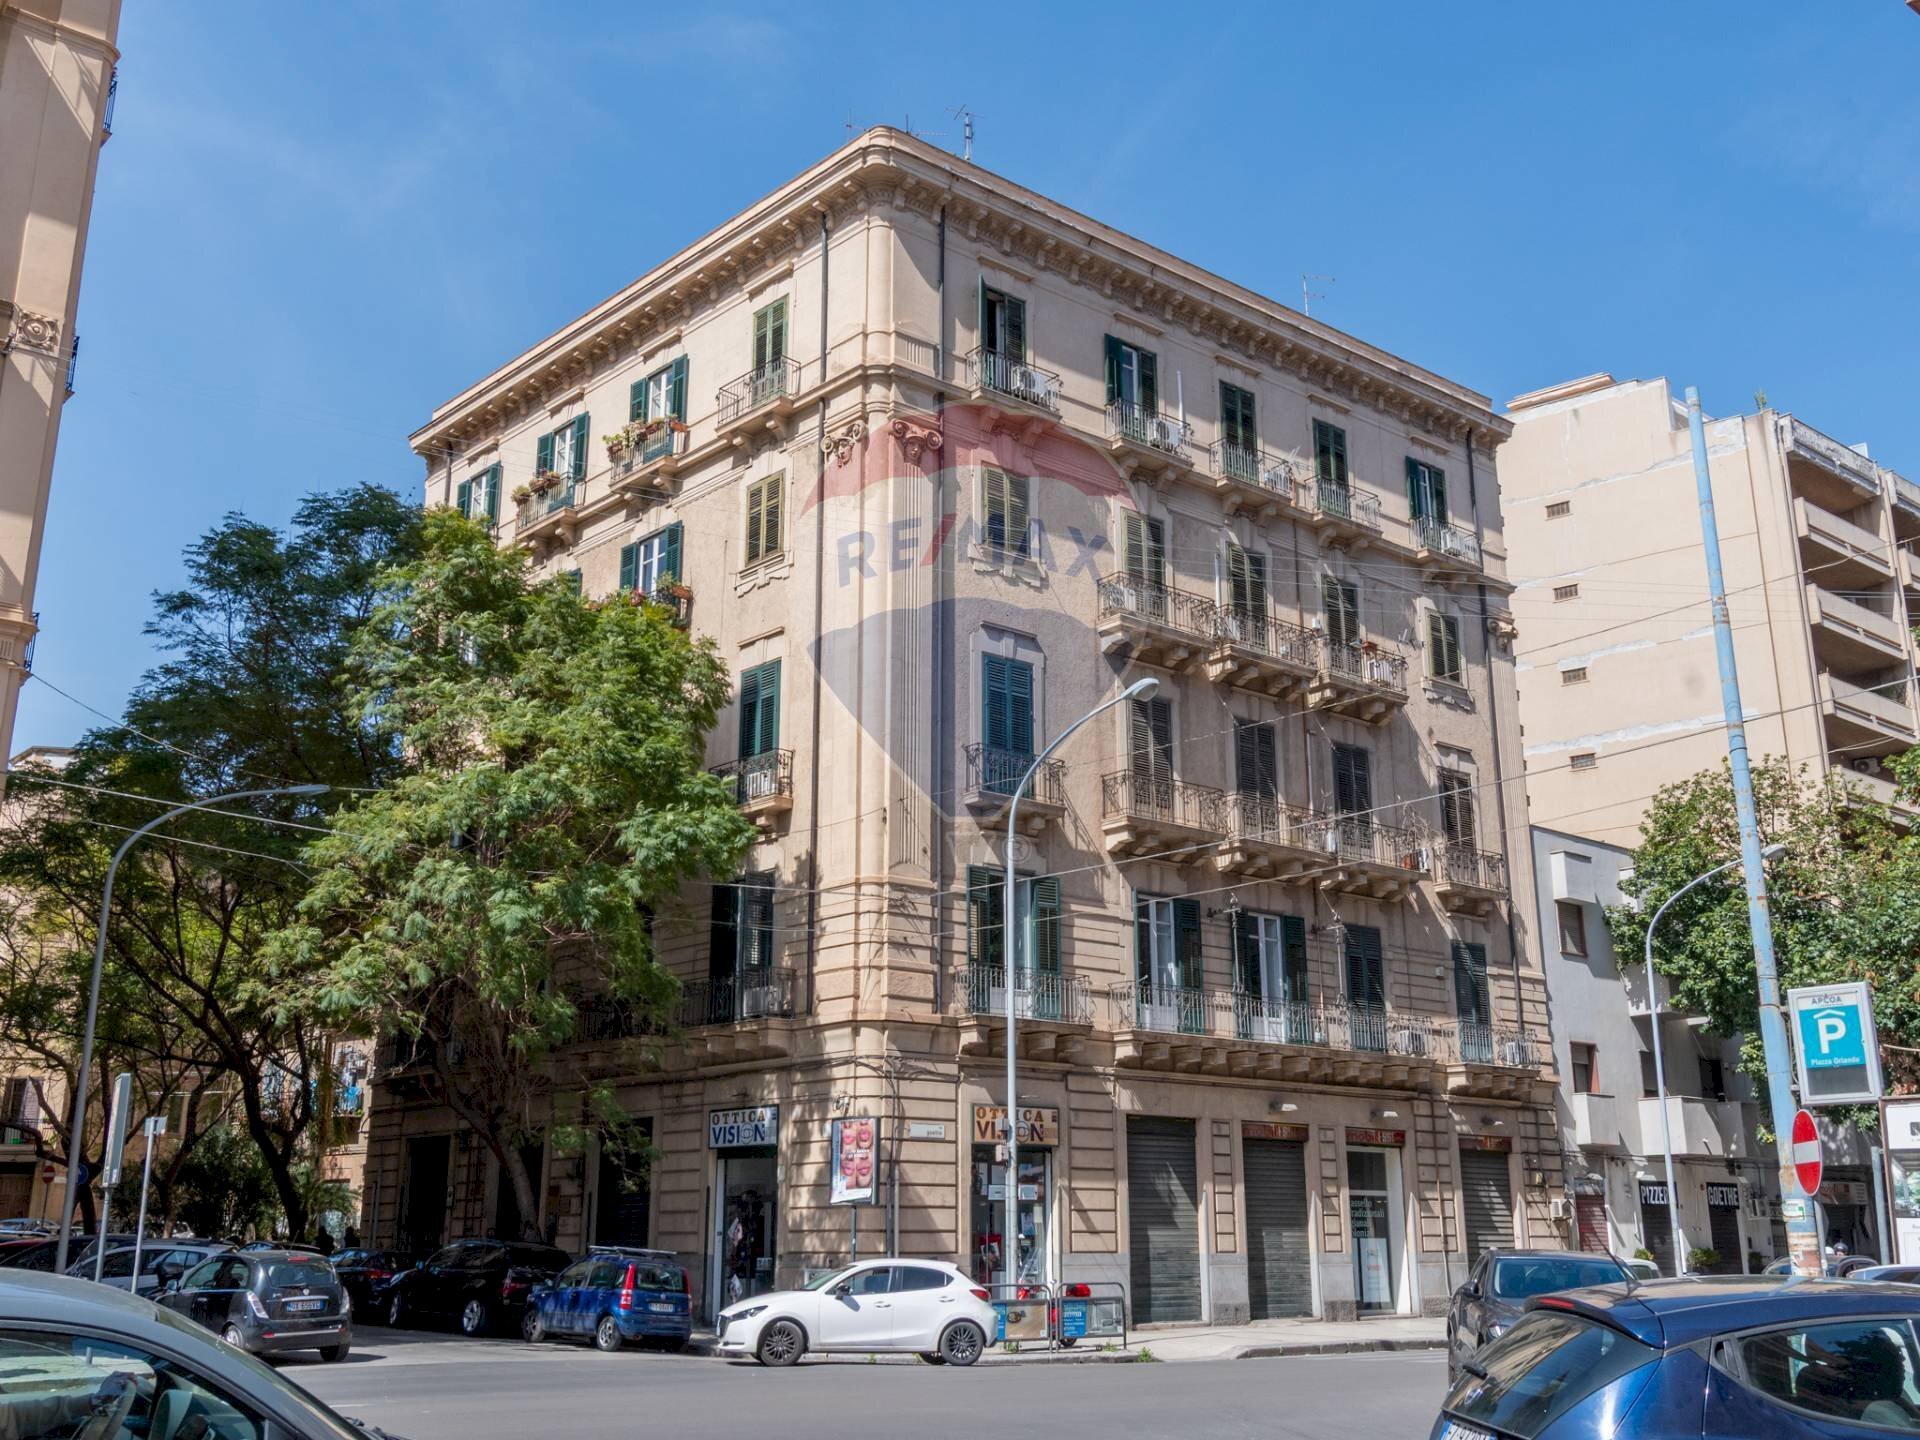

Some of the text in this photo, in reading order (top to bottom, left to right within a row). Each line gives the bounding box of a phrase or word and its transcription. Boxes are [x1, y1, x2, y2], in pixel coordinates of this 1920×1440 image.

[1811, 995, 1842, 1005] APCOA
[1817, 1017, 1847, 1054] P
[1811, 1056, 1860, 1066] Piazza Orlando
[712, 1110, 766, 1126] OTTICA
[712, 1123, 766, 1145] VISION
[976, 1120, 1044, 1143] VION
[1640, 1185, 1738, 1206] PIZZER GOETHE
